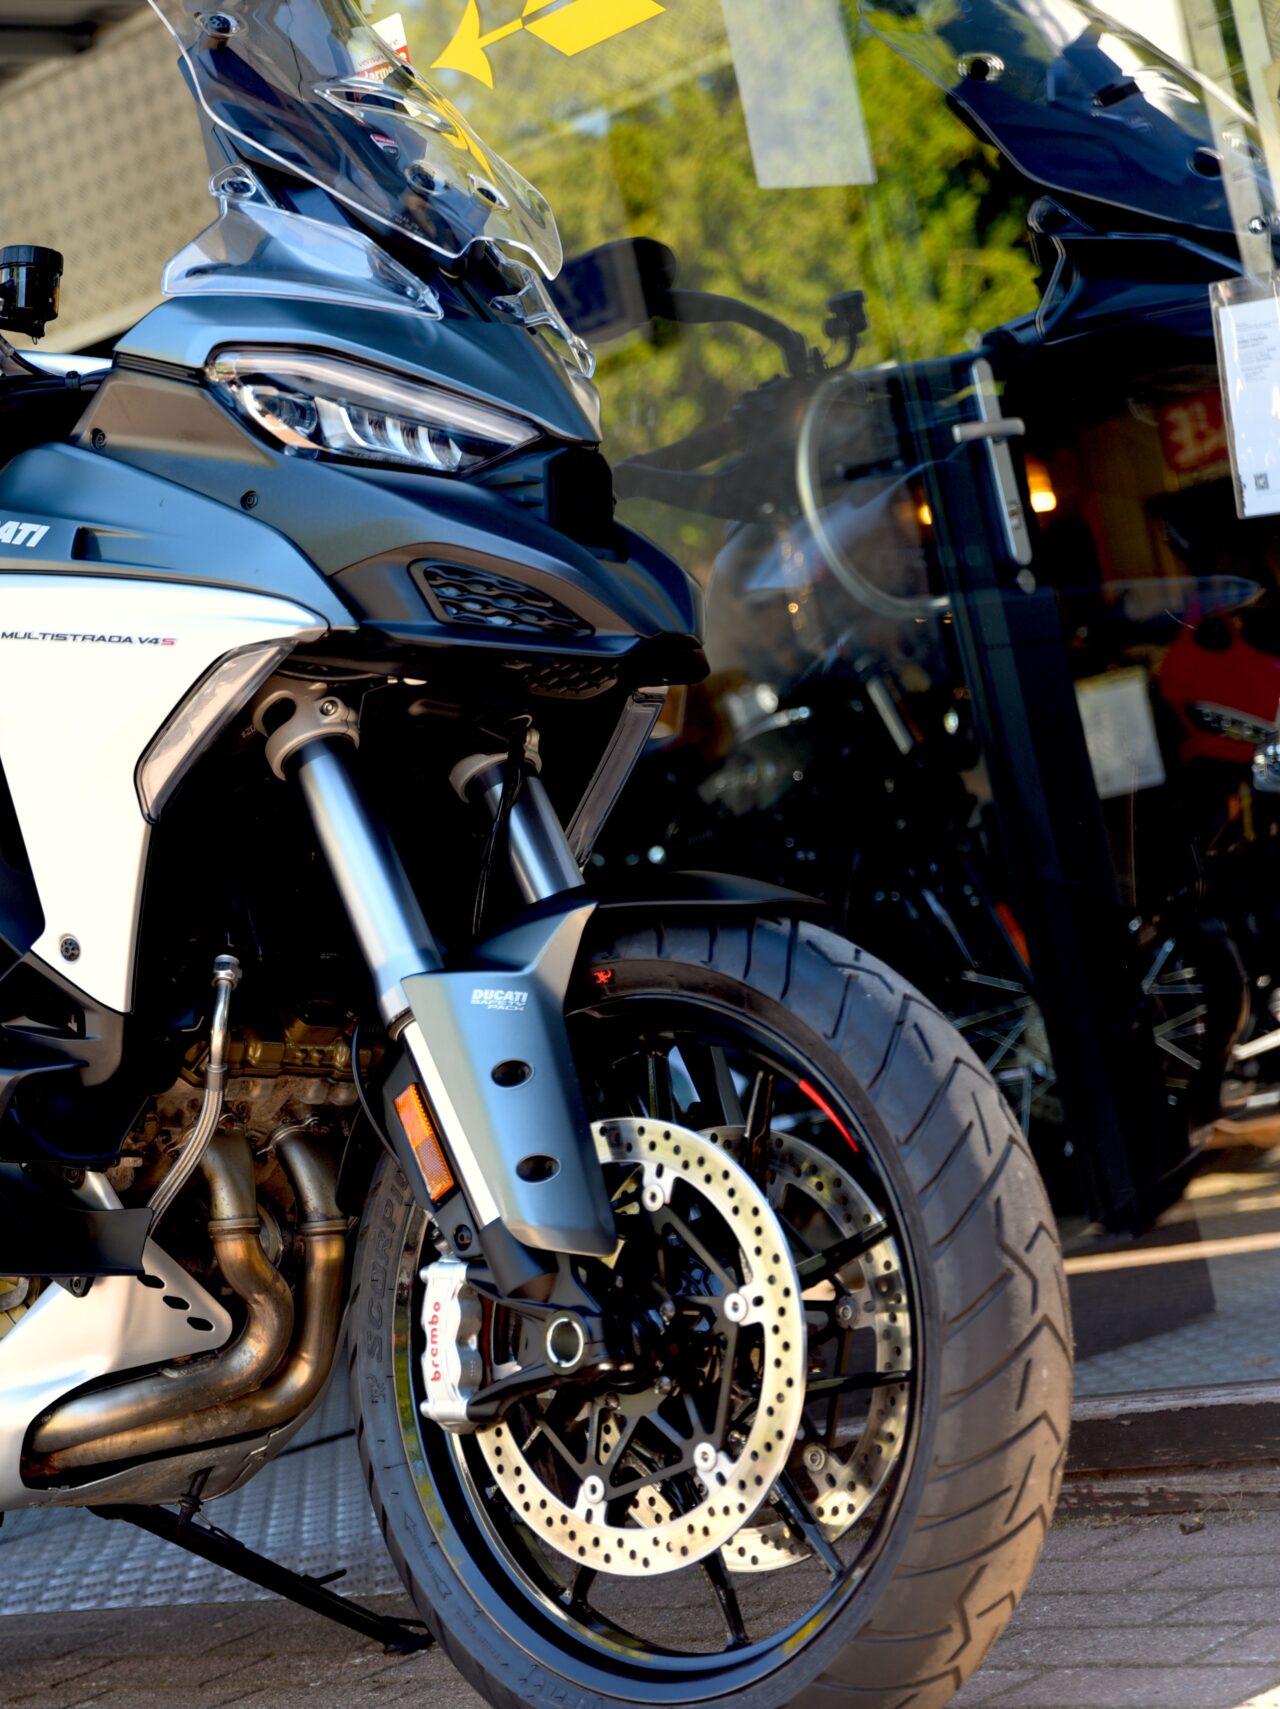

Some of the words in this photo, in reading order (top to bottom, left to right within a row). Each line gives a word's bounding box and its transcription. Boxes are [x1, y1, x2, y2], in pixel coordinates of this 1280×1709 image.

[1, 630, 133, 645] MULTISTRADA
[138, 635, 177, 646] V4S
[471, 989, 528, 1003] DUCATI
[427, 1300, 442, 1383] brembo
